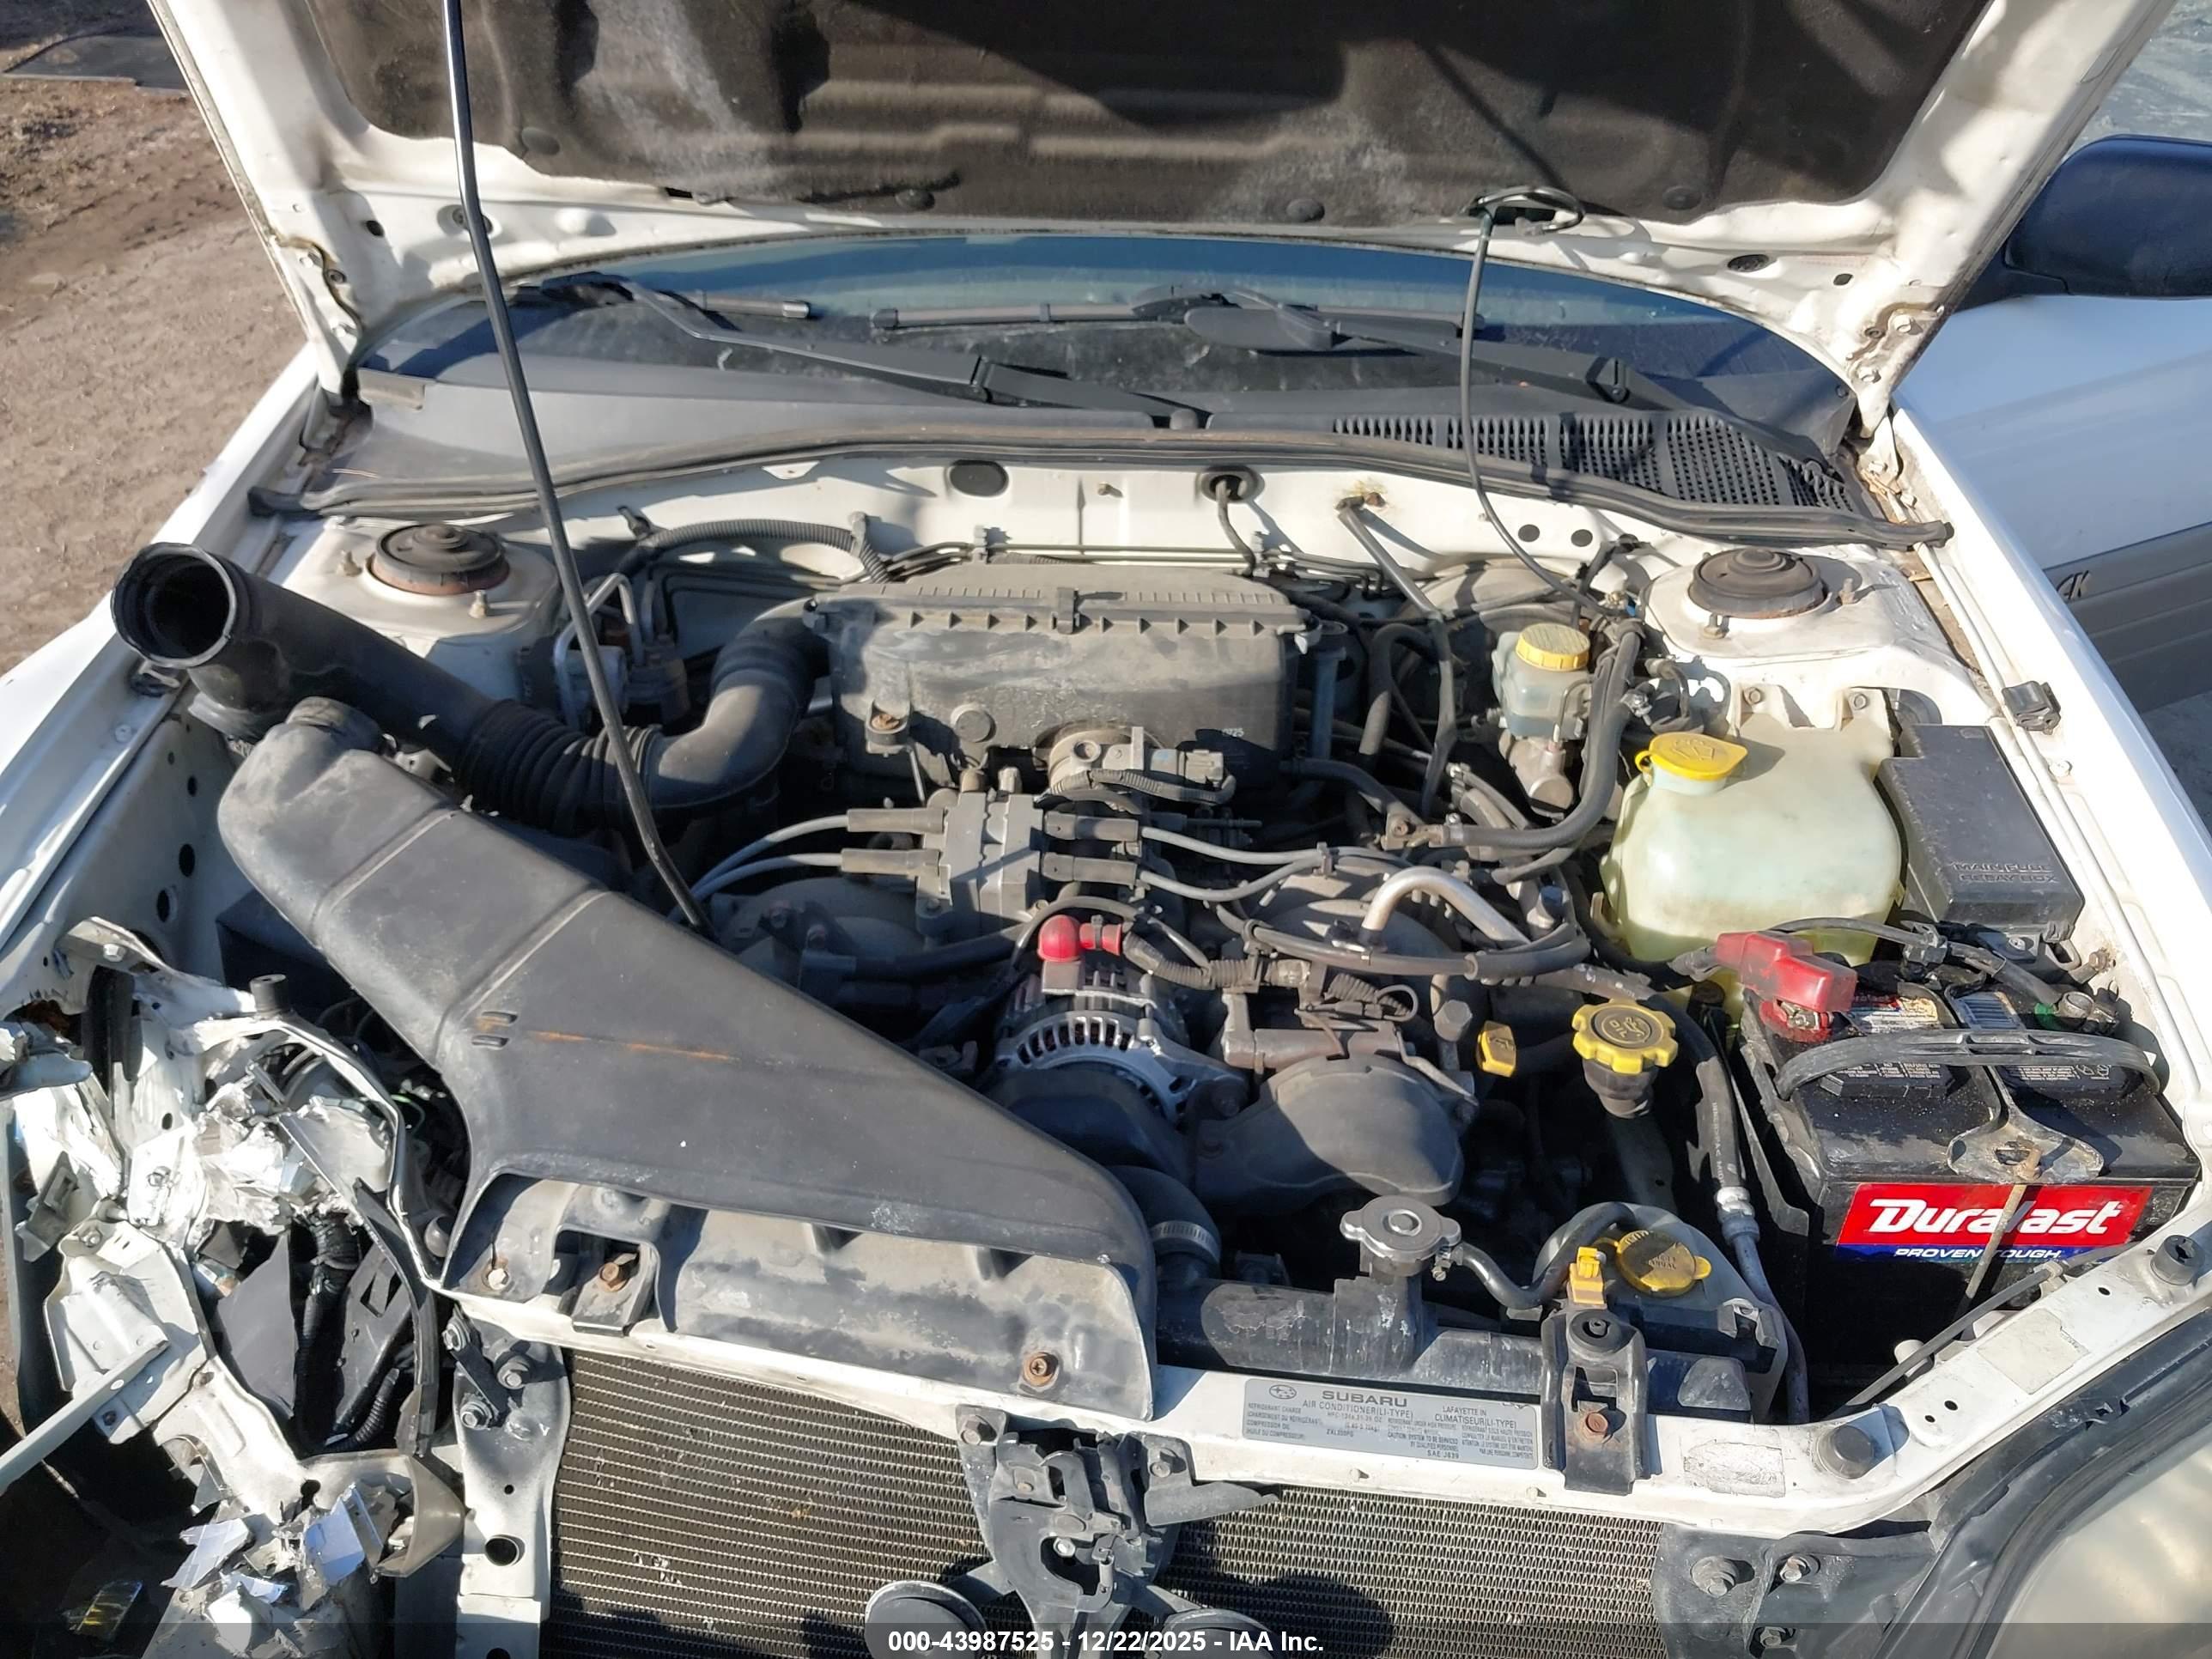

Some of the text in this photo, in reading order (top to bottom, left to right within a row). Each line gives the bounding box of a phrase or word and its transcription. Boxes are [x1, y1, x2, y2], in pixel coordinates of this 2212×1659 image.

[1952, 862, 2001, 872] MAIN
[2019, 874, 2061, 884] BOX
[1608, 1019, 1628, 1038] OIL
[1868, 1198, 2121, 1235] Duralast
[1893, 1248, 1984, 1259] PROVEN
[1302, 1399, 1316, 1409] AIR
[1322, 1390, 1407, 1407] SUBARU
[1442, 1406, 1478, 1417] LAFAYETTE
[1427, 1449, 1441, 1458] SAE
